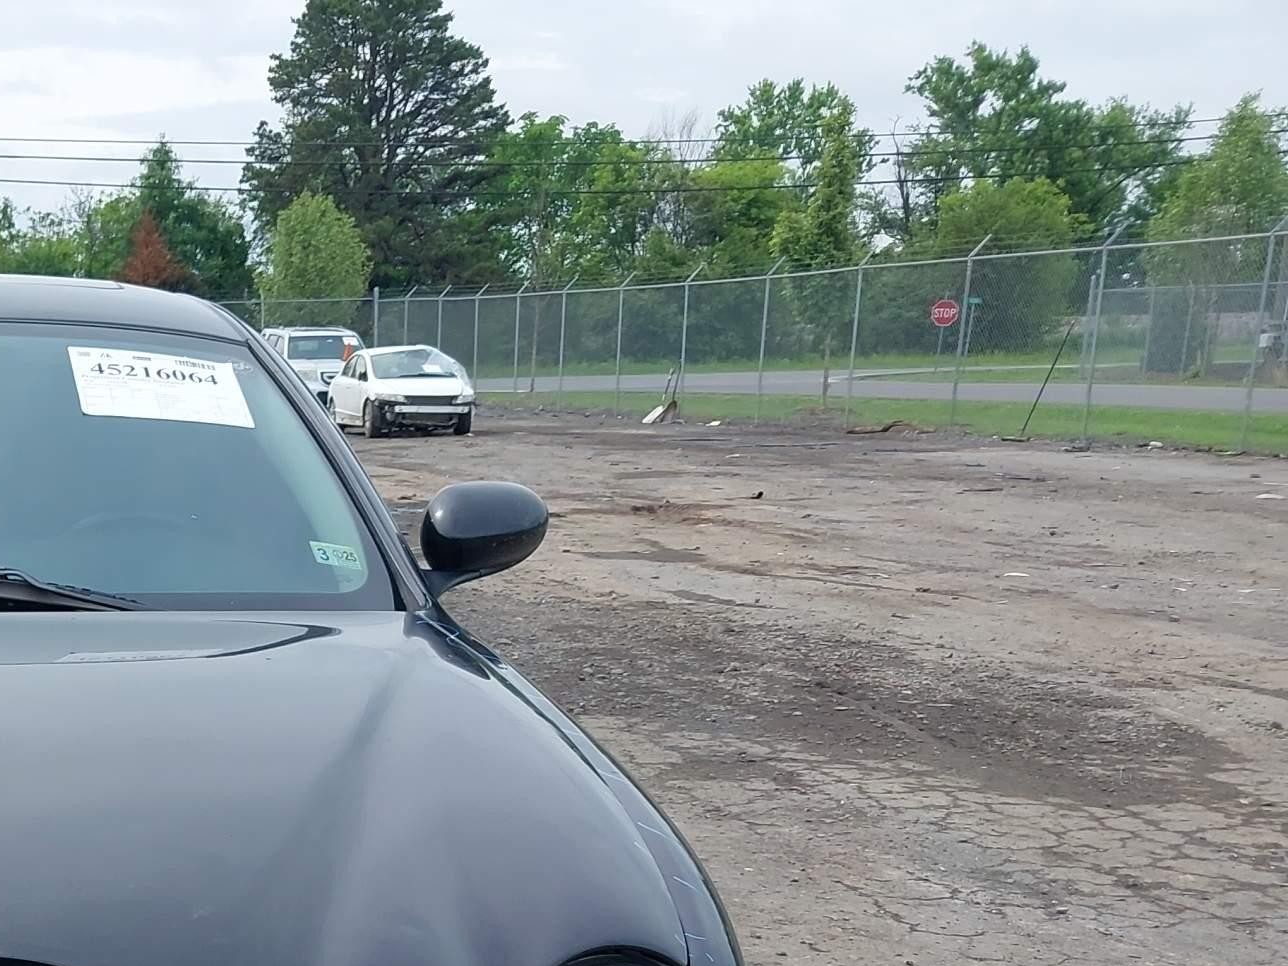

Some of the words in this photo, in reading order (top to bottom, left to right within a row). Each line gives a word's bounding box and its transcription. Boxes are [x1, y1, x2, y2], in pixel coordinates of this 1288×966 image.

[934, 308, 957, 318] STOP
[90, 362, 218, 385] 45216064
[317, 547, 330, 561] 3
